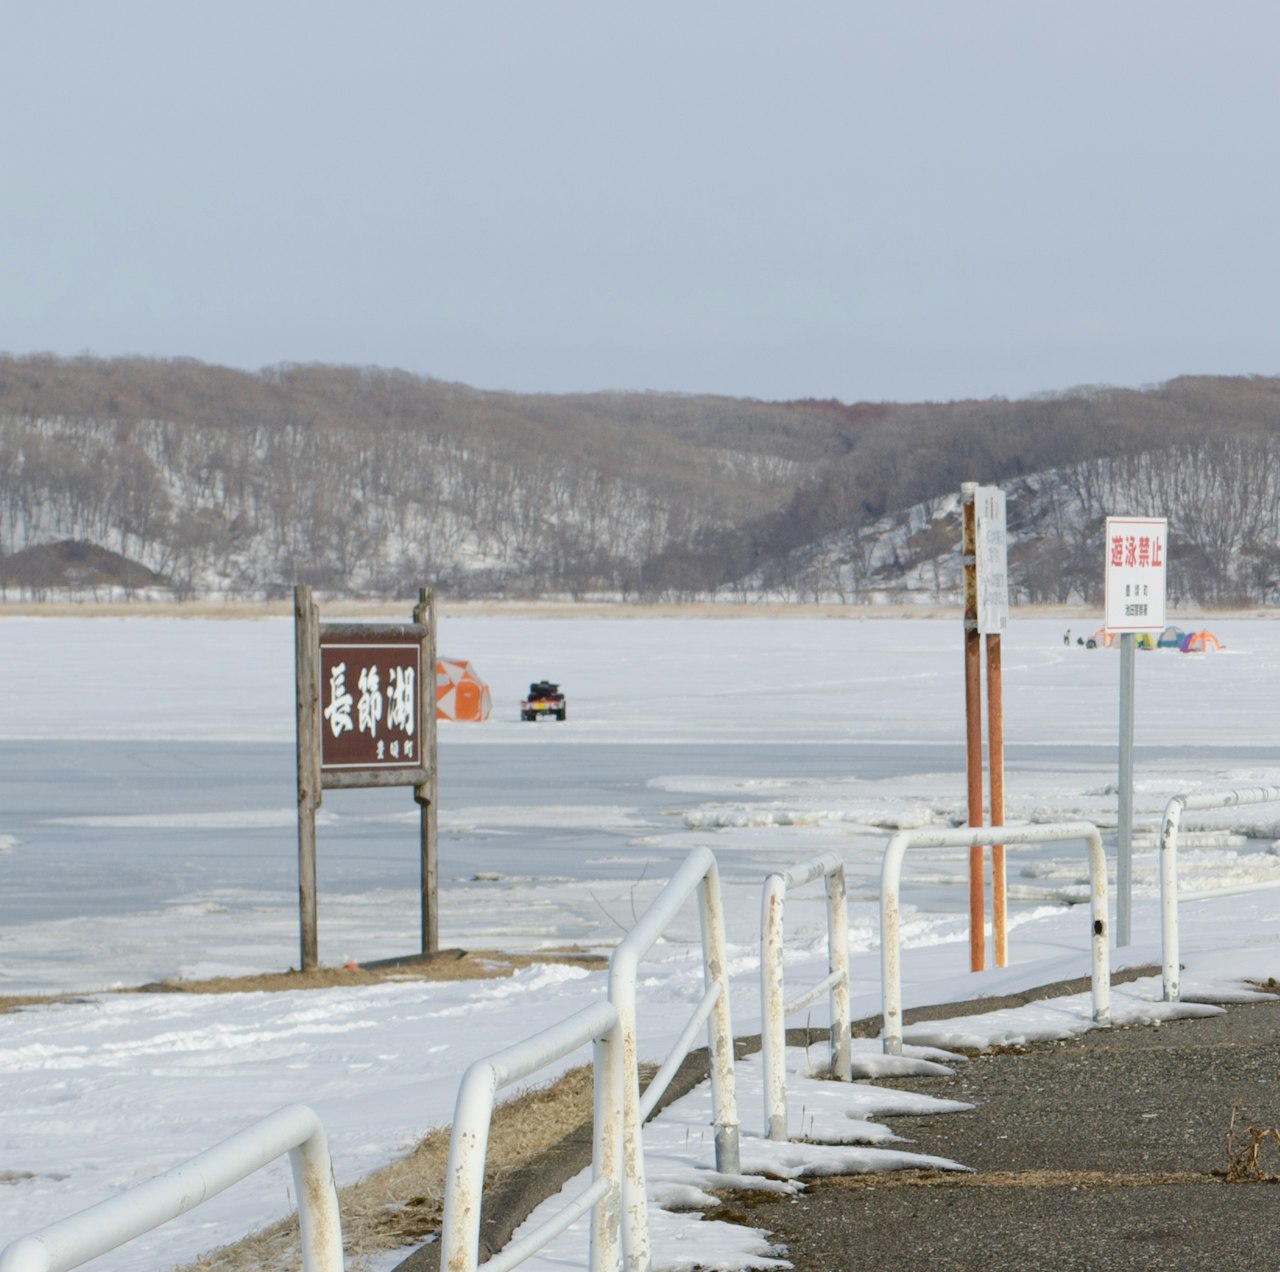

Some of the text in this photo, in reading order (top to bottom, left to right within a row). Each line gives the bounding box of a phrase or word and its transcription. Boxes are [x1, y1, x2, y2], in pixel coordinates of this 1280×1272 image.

[1111, 535, 1162, 568] 遊泳禁止
[324, 662, 415, 738] 長節湖
